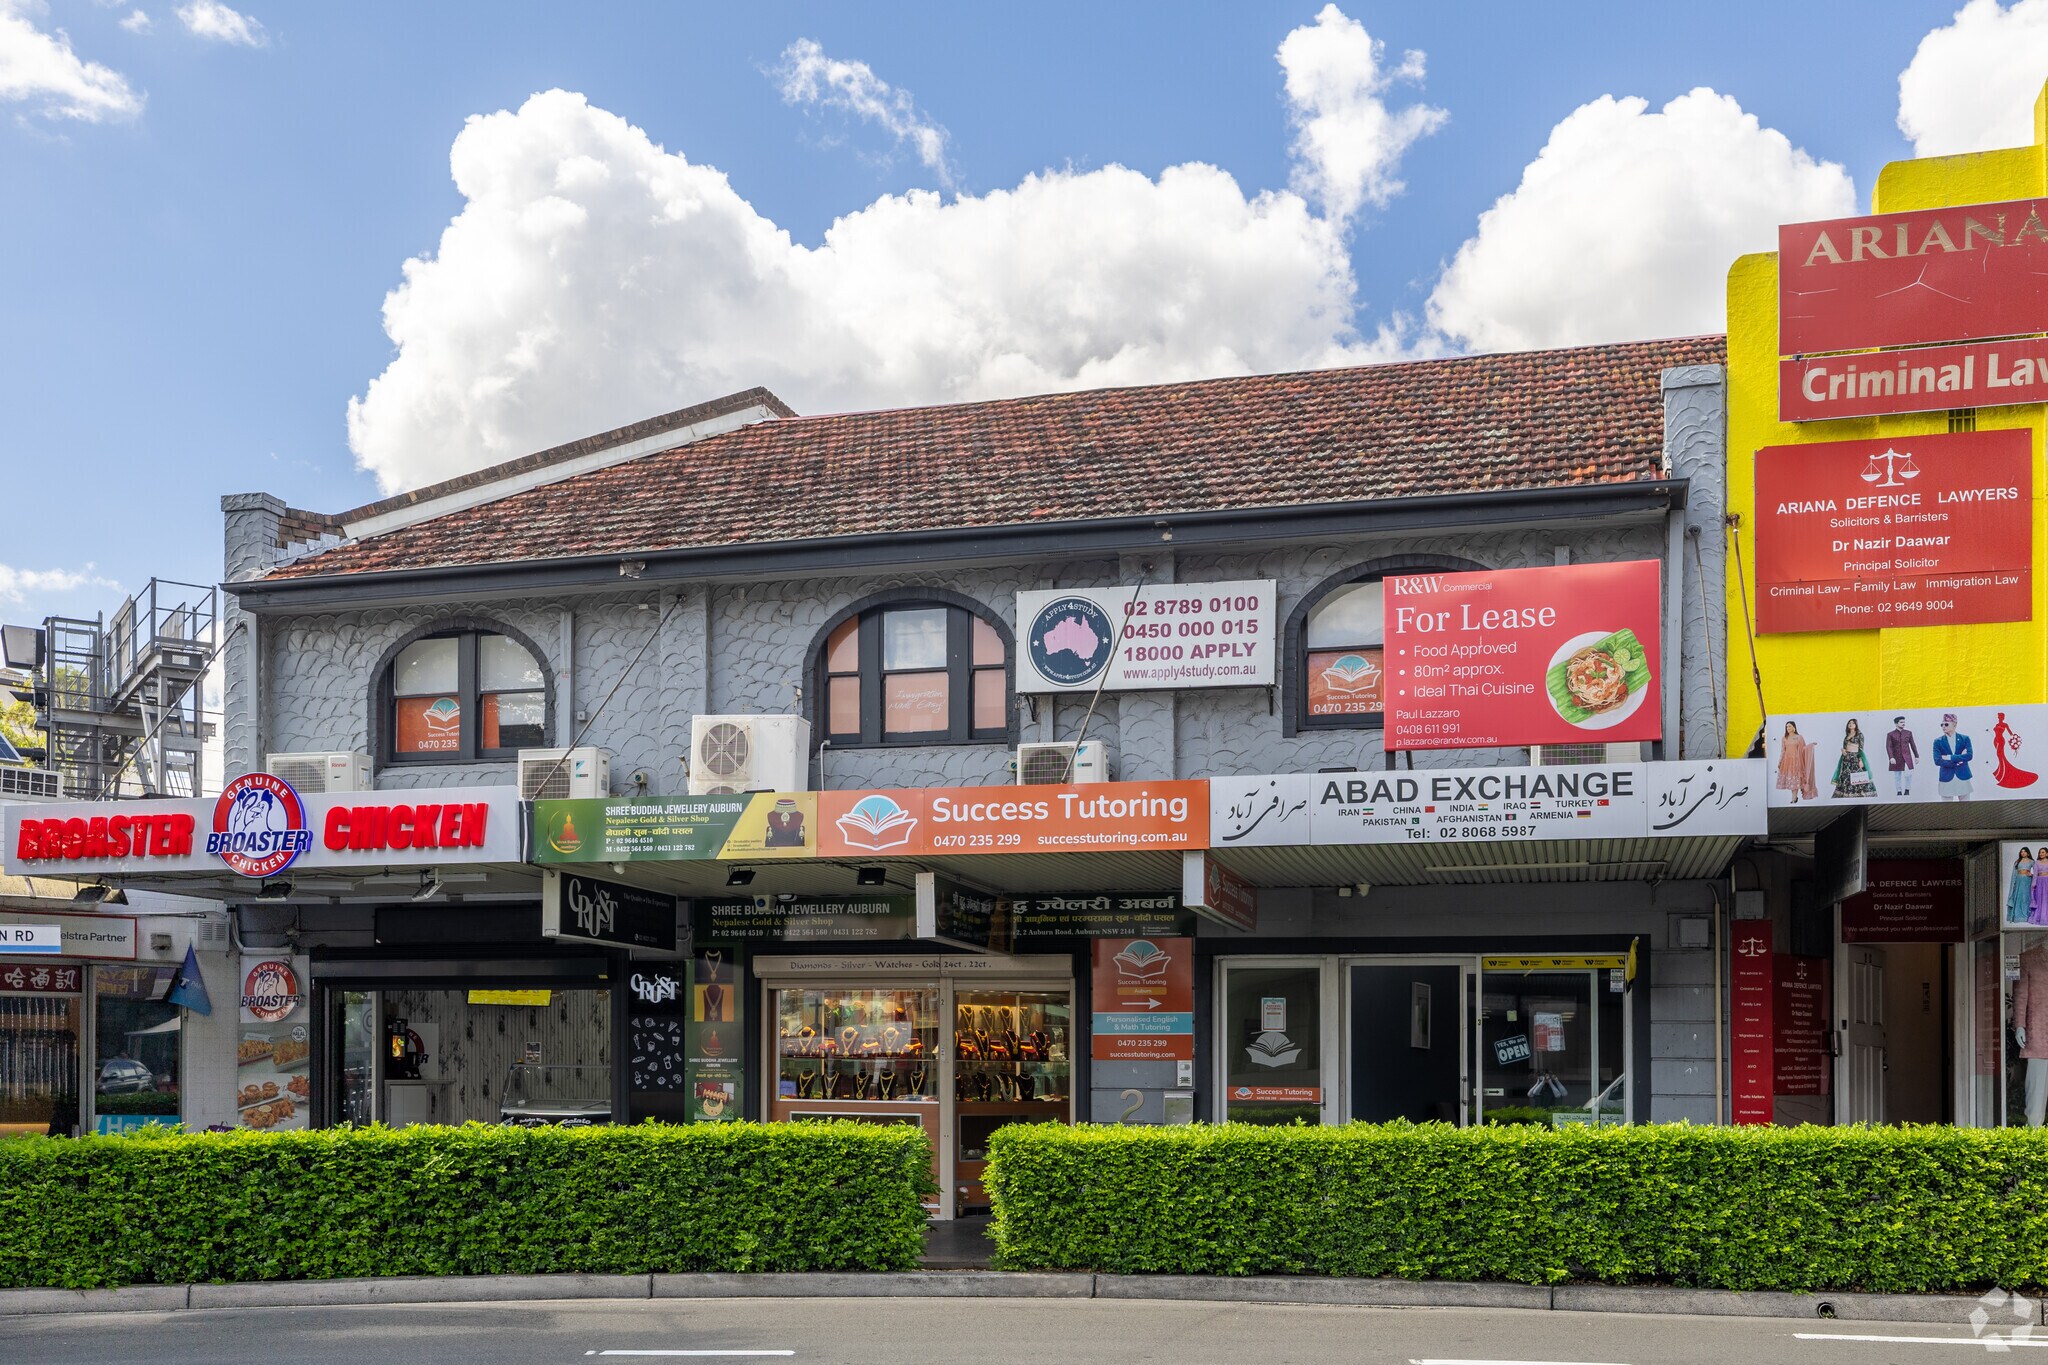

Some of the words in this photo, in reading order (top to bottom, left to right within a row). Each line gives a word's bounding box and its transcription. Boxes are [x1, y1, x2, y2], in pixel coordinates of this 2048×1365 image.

[1801, 210, 2048, 267] ARIANA
[1802, 355, 1974, 402] Criminal
[1776, 500, 1837, 514] ARIANA
[1846, 494, 1921, 510] DEFENCE
[1938, 487, 2019, 504] LAWYERS
[1830, 515, 1880, 528] Solicitors
[1883, 514, 1892, 524] &
[1895, 512, 1949, 524] Barristers
[1832, 540, 1850, 552] Dr
[1853, 537, 1892, 550] Nazir
[1895, 535, 1950, 548] Daawar
[1844, 560, 1891, 572] Principal
[1894, 557, 1939, 569] Solicitor
[1394, 576, 1444, 595] R&W
[1443, 582, 1492, 593] Commercial
[1770, 585, 1814, 597] Criminal
[1818, 583, 1840, 594] Law
[1854, 581, 1890, 594] Family
[1893, 580, 1916, 590] Law
[1926, 577, 1992, 590] Immigration
[1995, 574, 2019, 586] Law
[1044, 602, 1099, 622] APPLY4STUDY
[1123, 601, 1148, 617] 02
[1154, 598, 1203, 615] 8789
[1209, 596, 1259, 613] 0100
[1835, 604, 1874, 615] Phone:
[1877, 602, 1892, 612] 02
[1894, 602, 1922, 612] 9649
[1926, 600, 1954, 610] 9004
[1395, 606, 1450, 634] For
[1460, 603, 1556, 631] Lease
[1123, 623, 1172, 640] 0450
[1178, 621, 1214, 637] 000
[1221, 619, 1259, 635] 015
[1123, 645, 1184, 662] 18000
[1190, 642, 1257, 659] APPLY
[1414, 644, 1448, 658] Food
[1451, 641, 1517, 659] Approved
[1123, 663, 1256, 680] www.apply4study.com.au
[1414, 664, 1450, 679] 80m²
[1453, 664, 1505, 679] approx.
[1414, 684, 1446, 698] Ideal
[1449, 683, 1479, 697] Thai
[1482, 681, 1534, 696] Cuisine
[1313, 703, 1342, 713] 0470
[1345, 702, 1366, 712] 235
[1369, 701, 1385, 712] 29
[1396, 709, 1418, 720] Paul
[1420, 708, 1460, 719] Lazzaro
[1396, 724, 1422, 735] 0408
[1424, 724, 1441, 734] 611
[1442, 724, 1460, 733] 991
[418, 740, 439, 748] 0470
[442, 739, 458, 748] 235
[1396, 735, 1498, 747] p.lazzaro@randw.com.au
[227, 776, 289, 800] GENUINE
[1320, 778, 1419, 805] ABAD
[1431, 771, 1633, 802] EXCHANGE
[605, 806, 630, 816] SHREE
[630, 804, 664, 816] BUDDHA
[664, 803, 708, 814] JEWELLERY
[709, 802, 743, 813] AUBURN
[932, 796, 1049, 823] Success
[1057, 791, 1188, 822] Tutoring
[1338, 808, 1360, 817] IRAN
[1392, 806, 1422, 815] CHINA
[1449, 804, 1474, 813] INDIA
[1503, 802, 1527, 811] IRAQ
[1555, 800, 1594, 809] TURKEY
[323, 802, 489, 850] CHICKEN
[606, 816, 638, 826] Nepalese
[640, 816, 657, 824] Gold
[658, 816, 666, 824] &
[667, 815, 688, 824] Silver
[690, 814, 710, 825] Shop
[1362, 816, 1407, 826] PAKISTAN
[1436, 814, 1502, 824] AFGHANISTAN
[1530, 810, 1574, 820] ARMENIA
[17, 813, 195, 860] BROASTER
[933, 835, 964, 847] 0470
[969, 834, 994, 846] 235
[996, 833, 1021, 846] 299
[1037, 830, 1188, 848] successtutoring.com.au
[1405, 828, 1431, 839] Tel:
[1439, 827, 1458, 838] 02
[1460, 826, 1497, 838] 8068
[1502, 825, 1536, 836] 5987
[206, 830, 311, 854] BROASTER
[231, 852, 286, 873] CHICKEN
[1879, 880, 1918, 888] DEFENCE
[1921, 879, 1962, 887] LAWYERS
[568, 878, 619, 937] CRUST
[15, 930, 34, 942] RD
[60, 932, 88, 941] elstra
[90, 932, 128, 942] Partner
[1075, 928, 1100, 936] Auburn
[252, 964, 289, 977] GENUINE
[790, 960, 832, 970] Diamonds
[874, 960, 913, 970] Watches
[969, 960, 987, 968] 22ct
[630, 973, 680, 1004] CRUST
[240, 994, 300, 1008] BROASTER
[255, 1007, 287, 1019] CHICKEN
[1152, 1016, 1178, 1024] English
[1140, 1024, 1171, 1032] Tutoring
[1110, 1052, 1176, 1060] successtutoring.com
[1498, 1045, 1530, 1062] OPEN
[1284, 1088, 1313, 1096] Tutoring
[1119, 1089, 1145, 1123] 2
